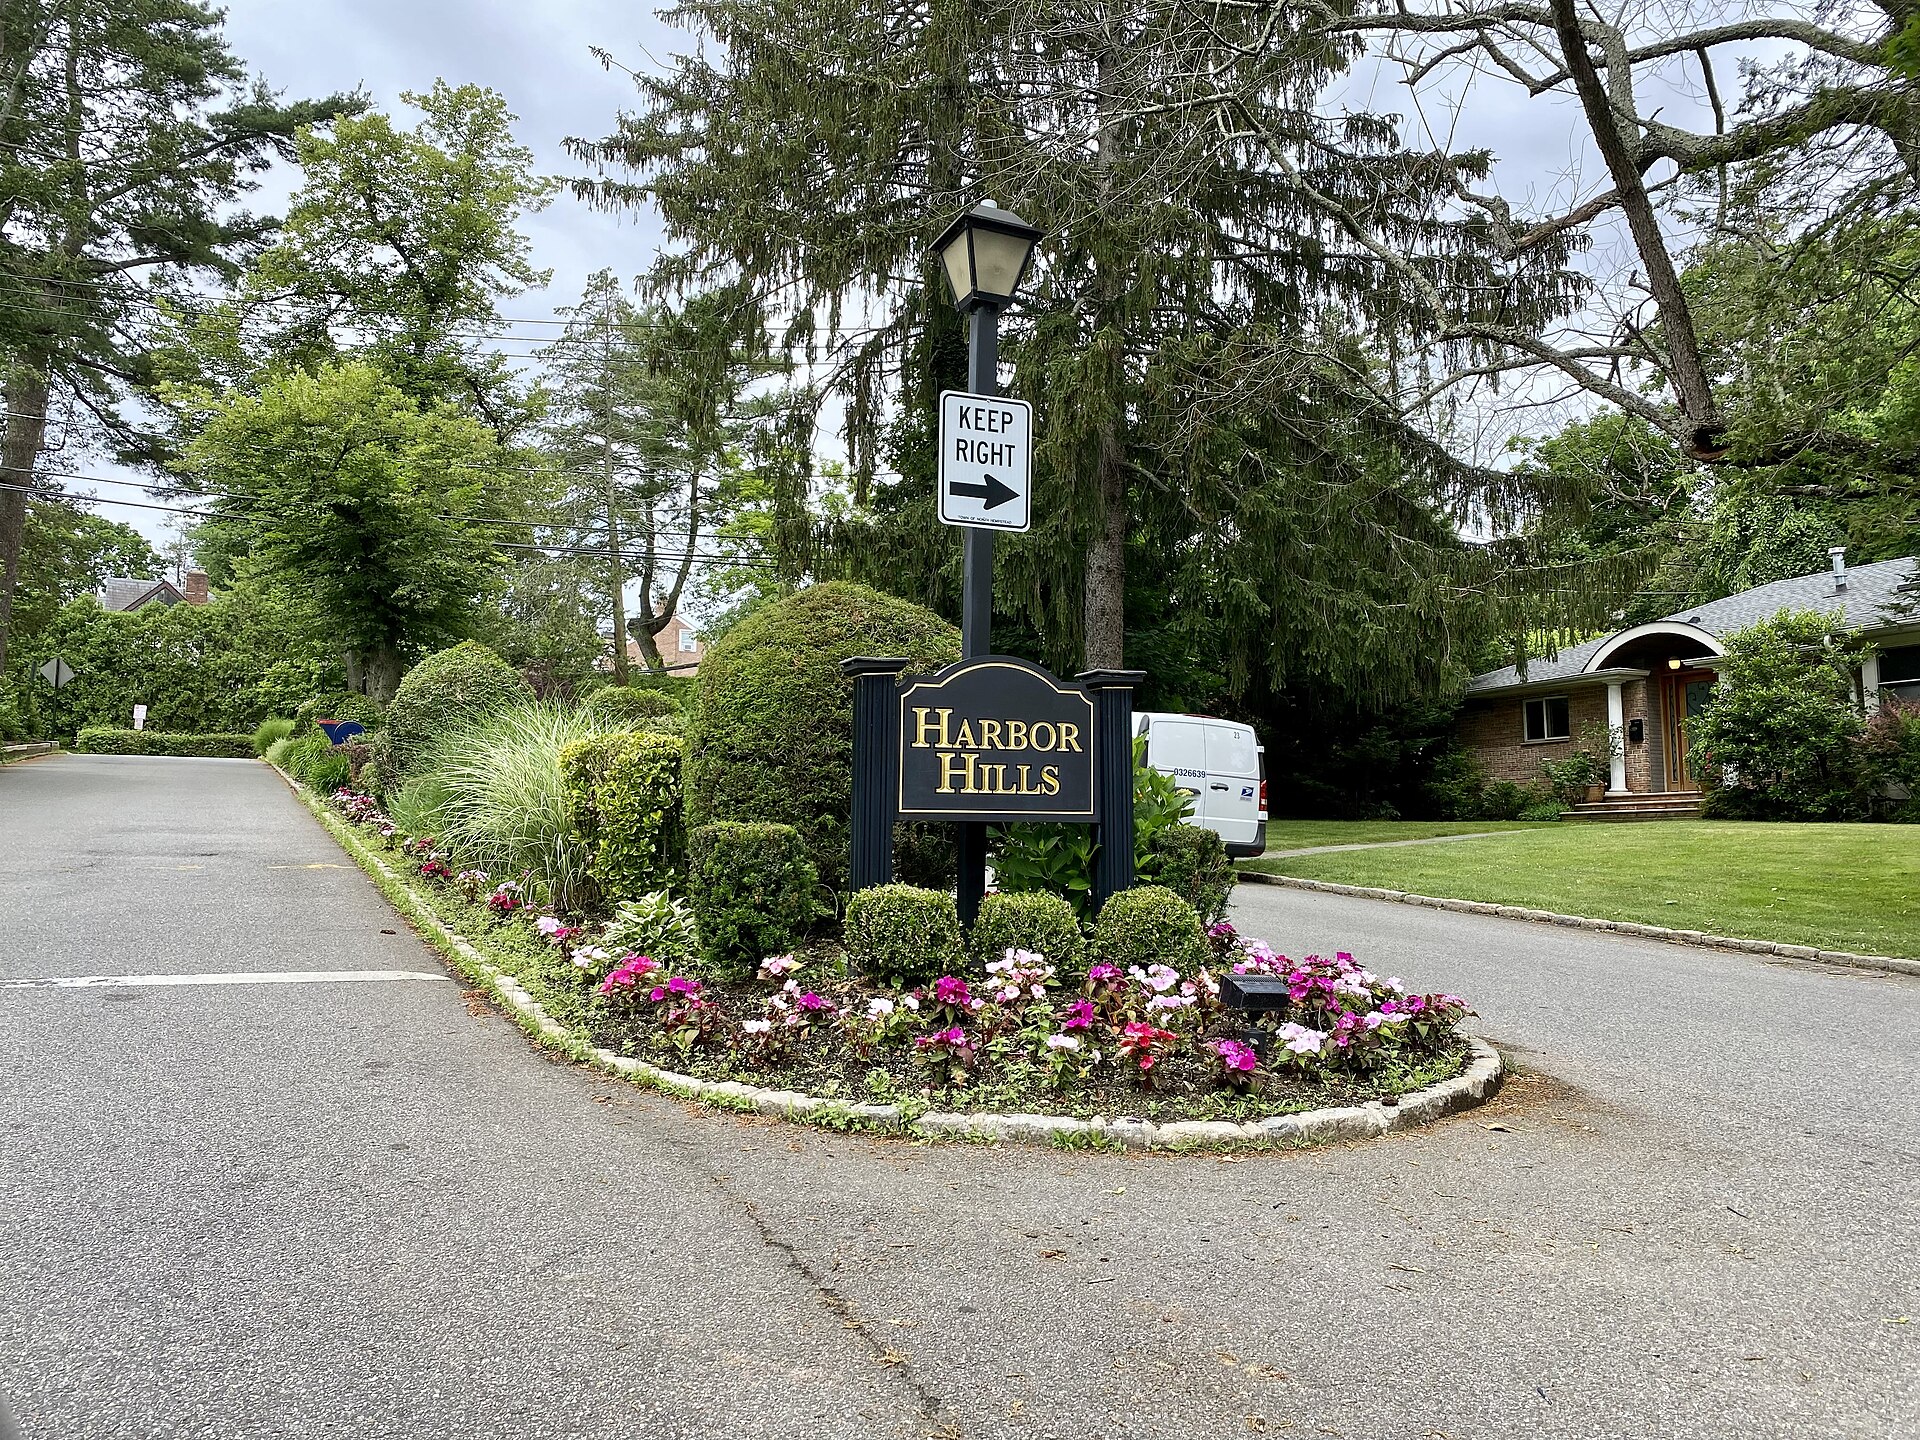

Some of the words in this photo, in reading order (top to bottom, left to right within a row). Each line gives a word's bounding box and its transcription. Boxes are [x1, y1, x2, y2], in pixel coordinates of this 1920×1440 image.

[959, 405, 1013, 434] KEEP
[956, 438, 1015, 467] RIGHT
[911, 707, 1083, 752] HARBOR
[935, 752, 1061, 795] HILLS
[1174, 768, 1206, 778] 0326639
